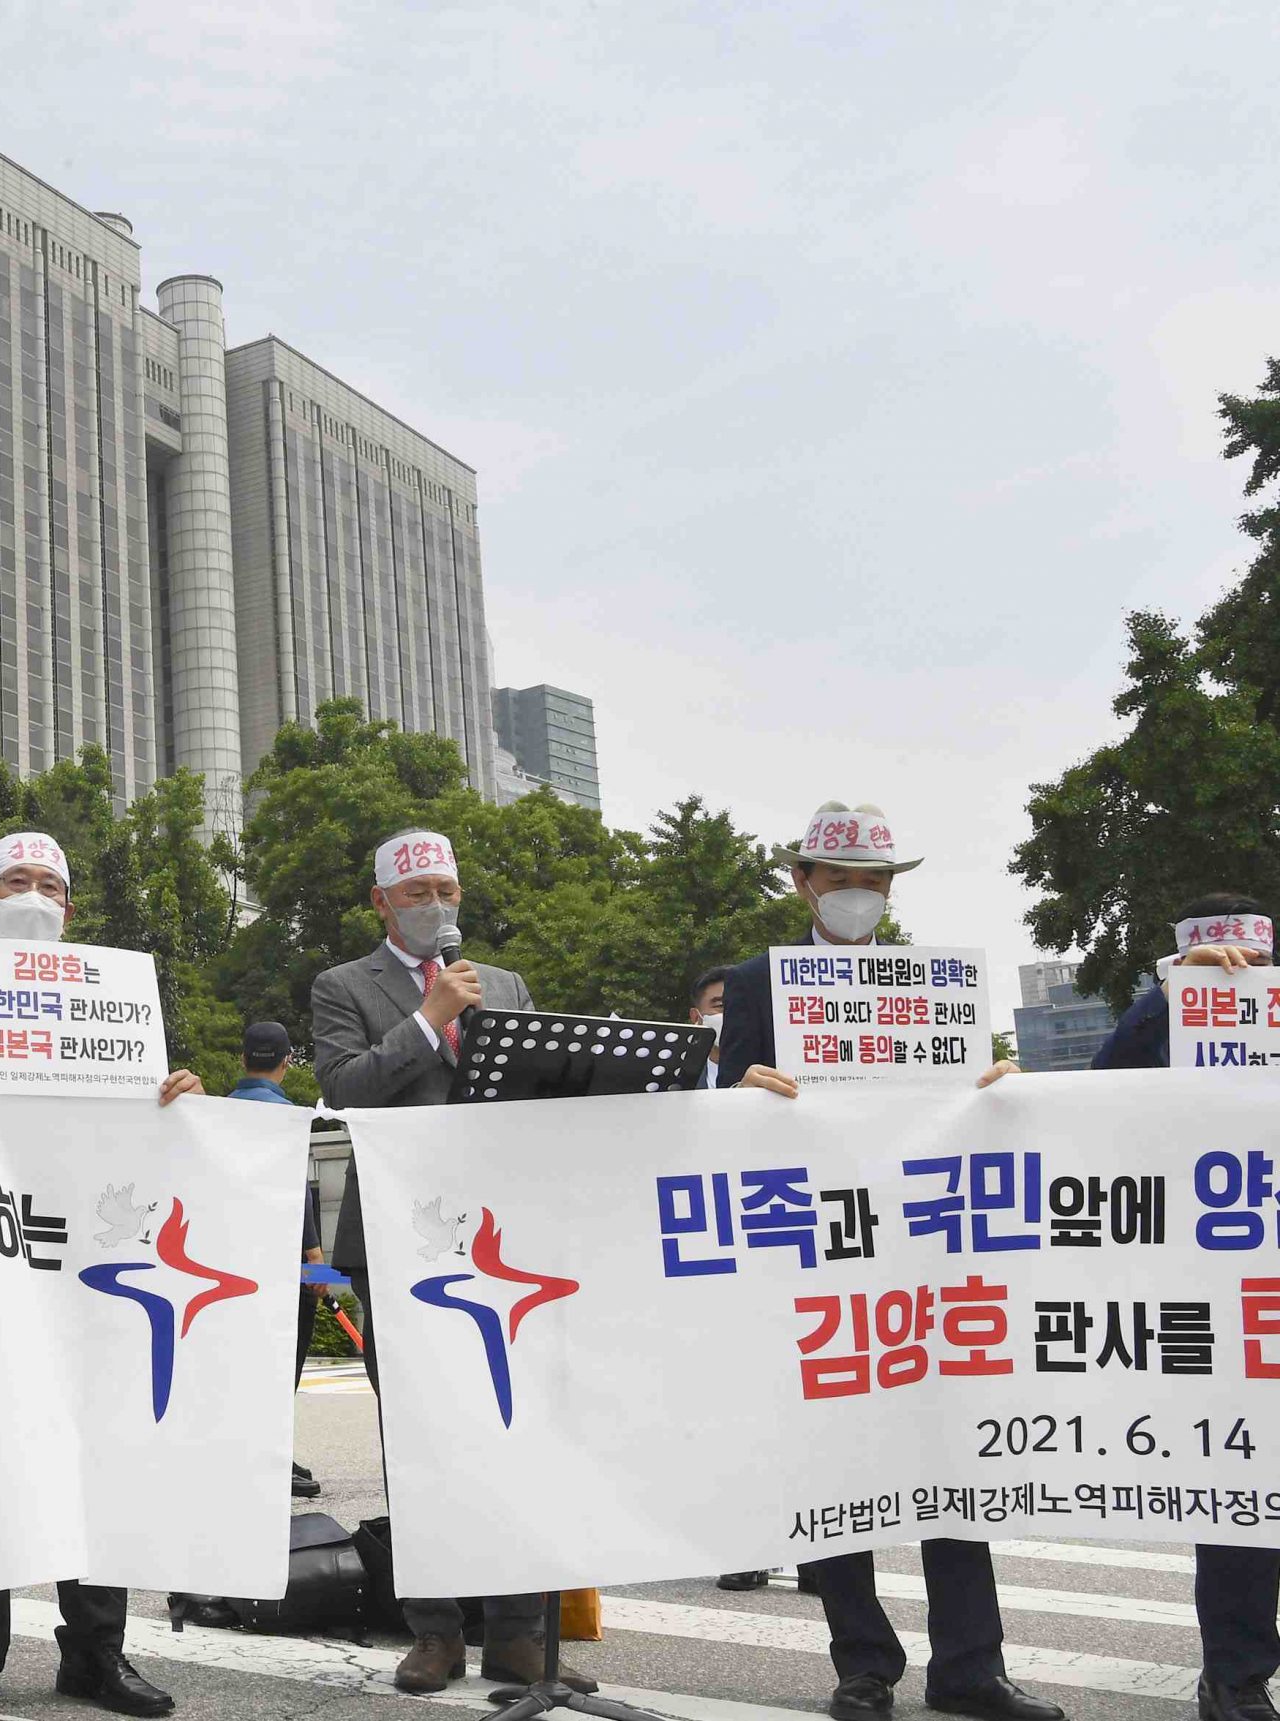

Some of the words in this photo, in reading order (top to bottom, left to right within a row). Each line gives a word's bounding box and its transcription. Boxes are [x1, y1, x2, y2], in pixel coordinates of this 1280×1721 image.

[13, 951, 101, 985] 김양호는
[780, 957, 854, 986] 대한민국
[858, 957, 926, 987] 대법원의
[930, 957, 978, 988] 명확한
[69, 998, 152, 1026] 판사인가?
[788, 996, 840, 1025] 판결이
[843, 1001, 873, 1024] 있다
[876, 995, 931, 1026] 김양호
[934, 1002, 976, 1026] 판사의
[1181, 987, 1259, 1028] 일본과
[59, 1036, 145, 1063] 판사인가?
[802, 1034, 854, 1064] 판결에
[858, 1035, 908, 1064] 동의할
[913, 1041, 927, 1063] 수
[931, 1036, 967, 1065] 없다
[656, 1167, 880, 1278] 민족과
[901, 1151, 1166, 1254] 국민앞에
[1192, 1148, 1280, 1252] 양
[793, 1275, 1014, 1401] 김양호
[1034, 1301, 1215, 1375] 판사를
[976, 1414, 1107, 1458] 2021.
[1126, 1414, 1171, 1458] 6.
[1193, 1417, 1256, 1460] 14
[788, 1491, 901, 1543] 사단법인
